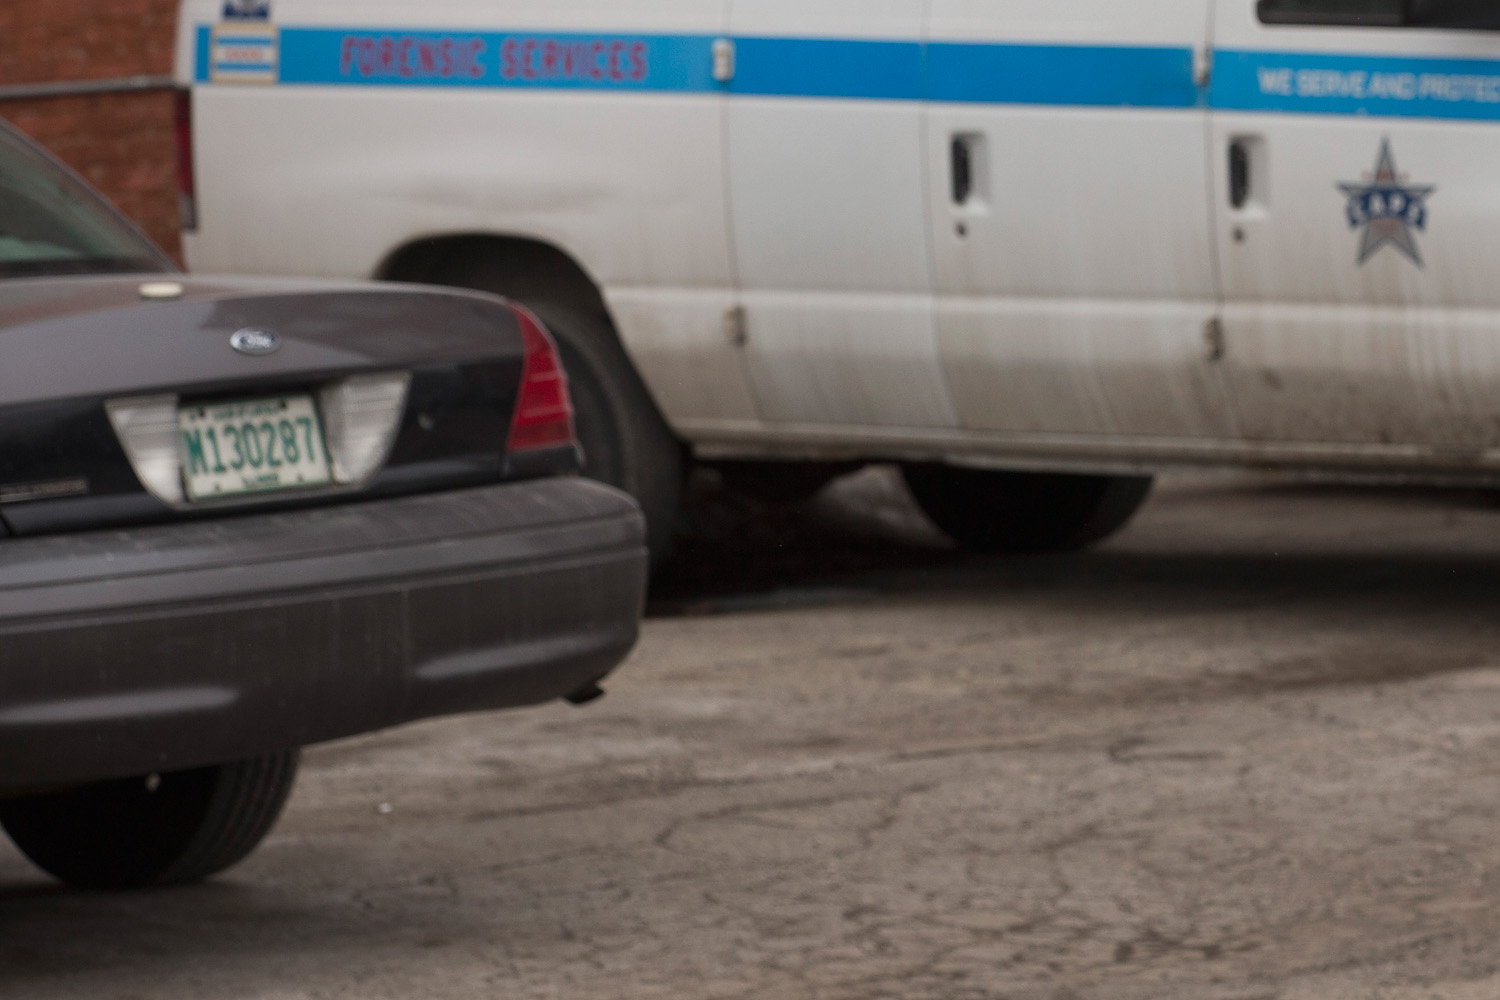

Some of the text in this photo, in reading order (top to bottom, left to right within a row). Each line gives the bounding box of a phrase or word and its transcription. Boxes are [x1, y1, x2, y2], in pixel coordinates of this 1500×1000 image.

[341, 35, 649, 81] FORENSIC SERVICES
[1258, 68, 1294, 96] WE
[1296, 69, 1368, 99] SERVE
[1369, 72, 1416, 100] AND
